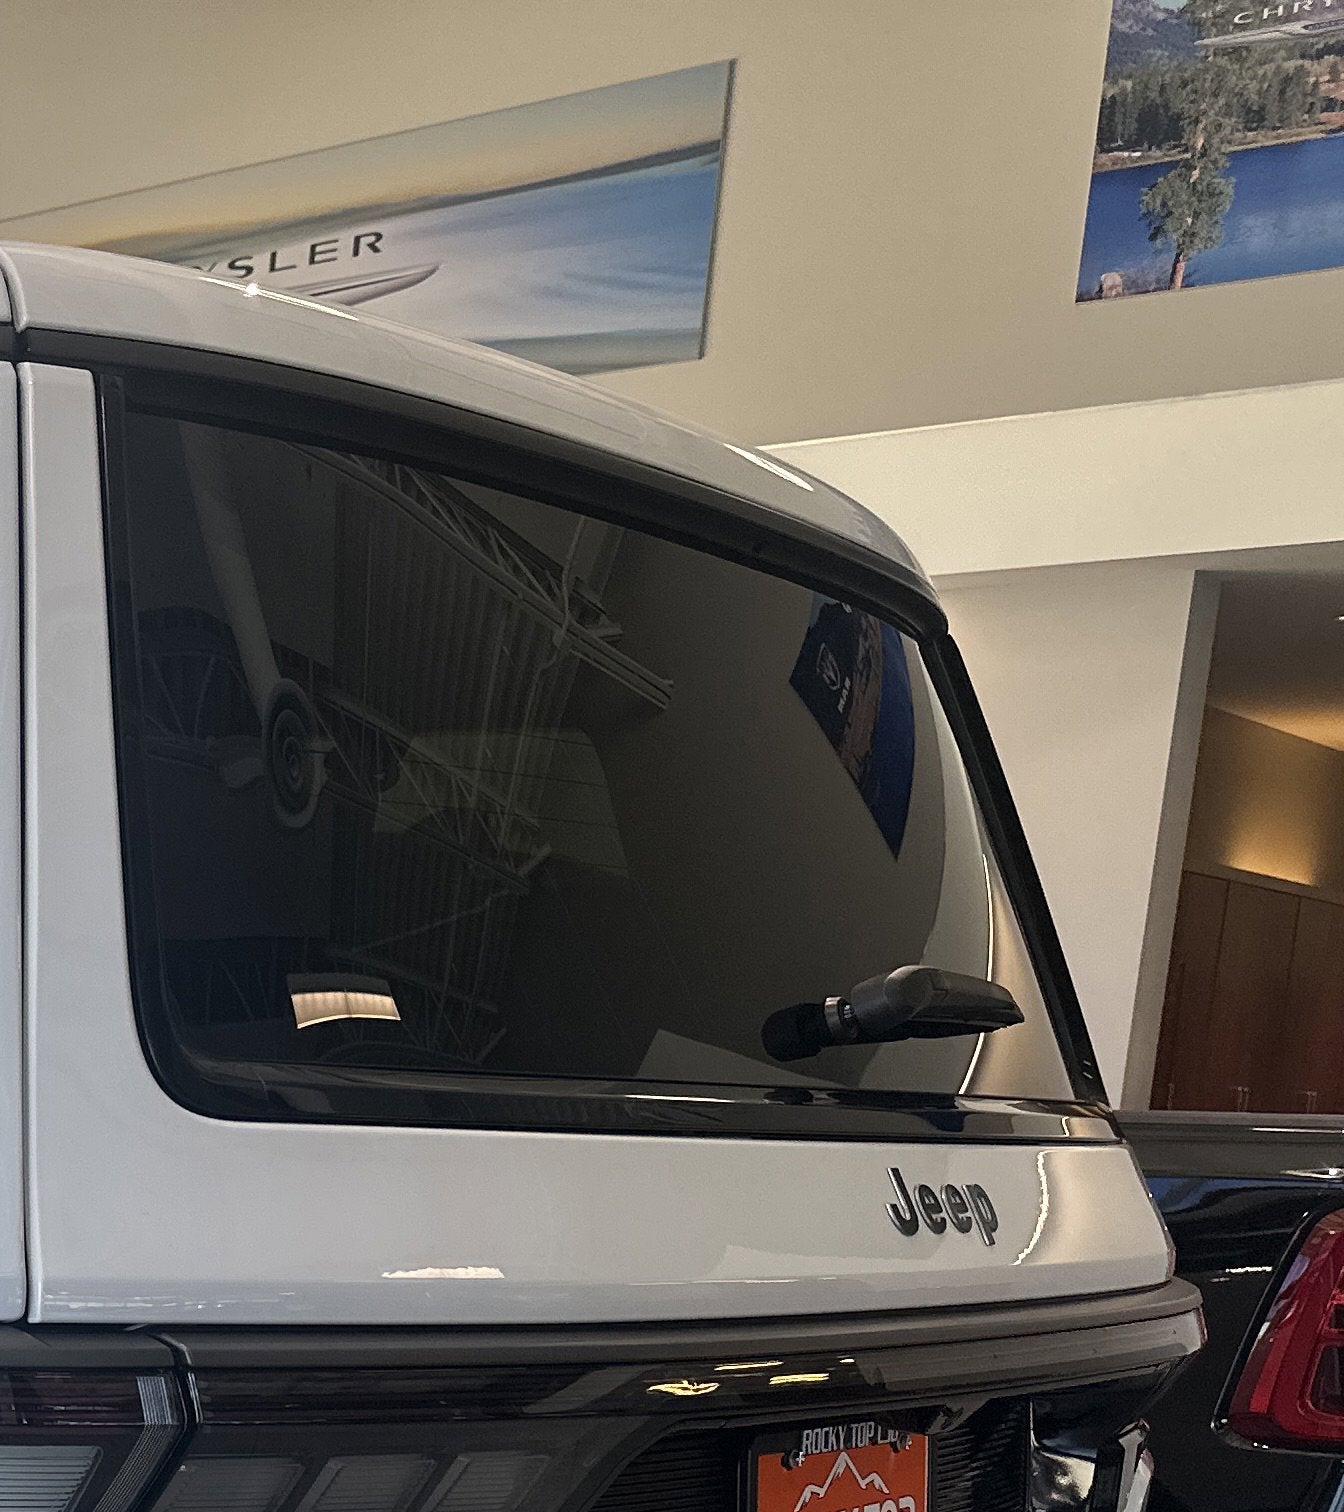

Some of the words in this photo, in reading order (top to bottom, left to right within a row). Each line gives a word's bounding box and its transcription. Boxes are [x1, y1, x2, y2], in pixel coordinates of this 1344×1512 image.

[885, 1167, 999, 1247] Jeep
[802, 1424, 848, 1454] ROCKY
[851, 1421, 875, 1449] TOP
